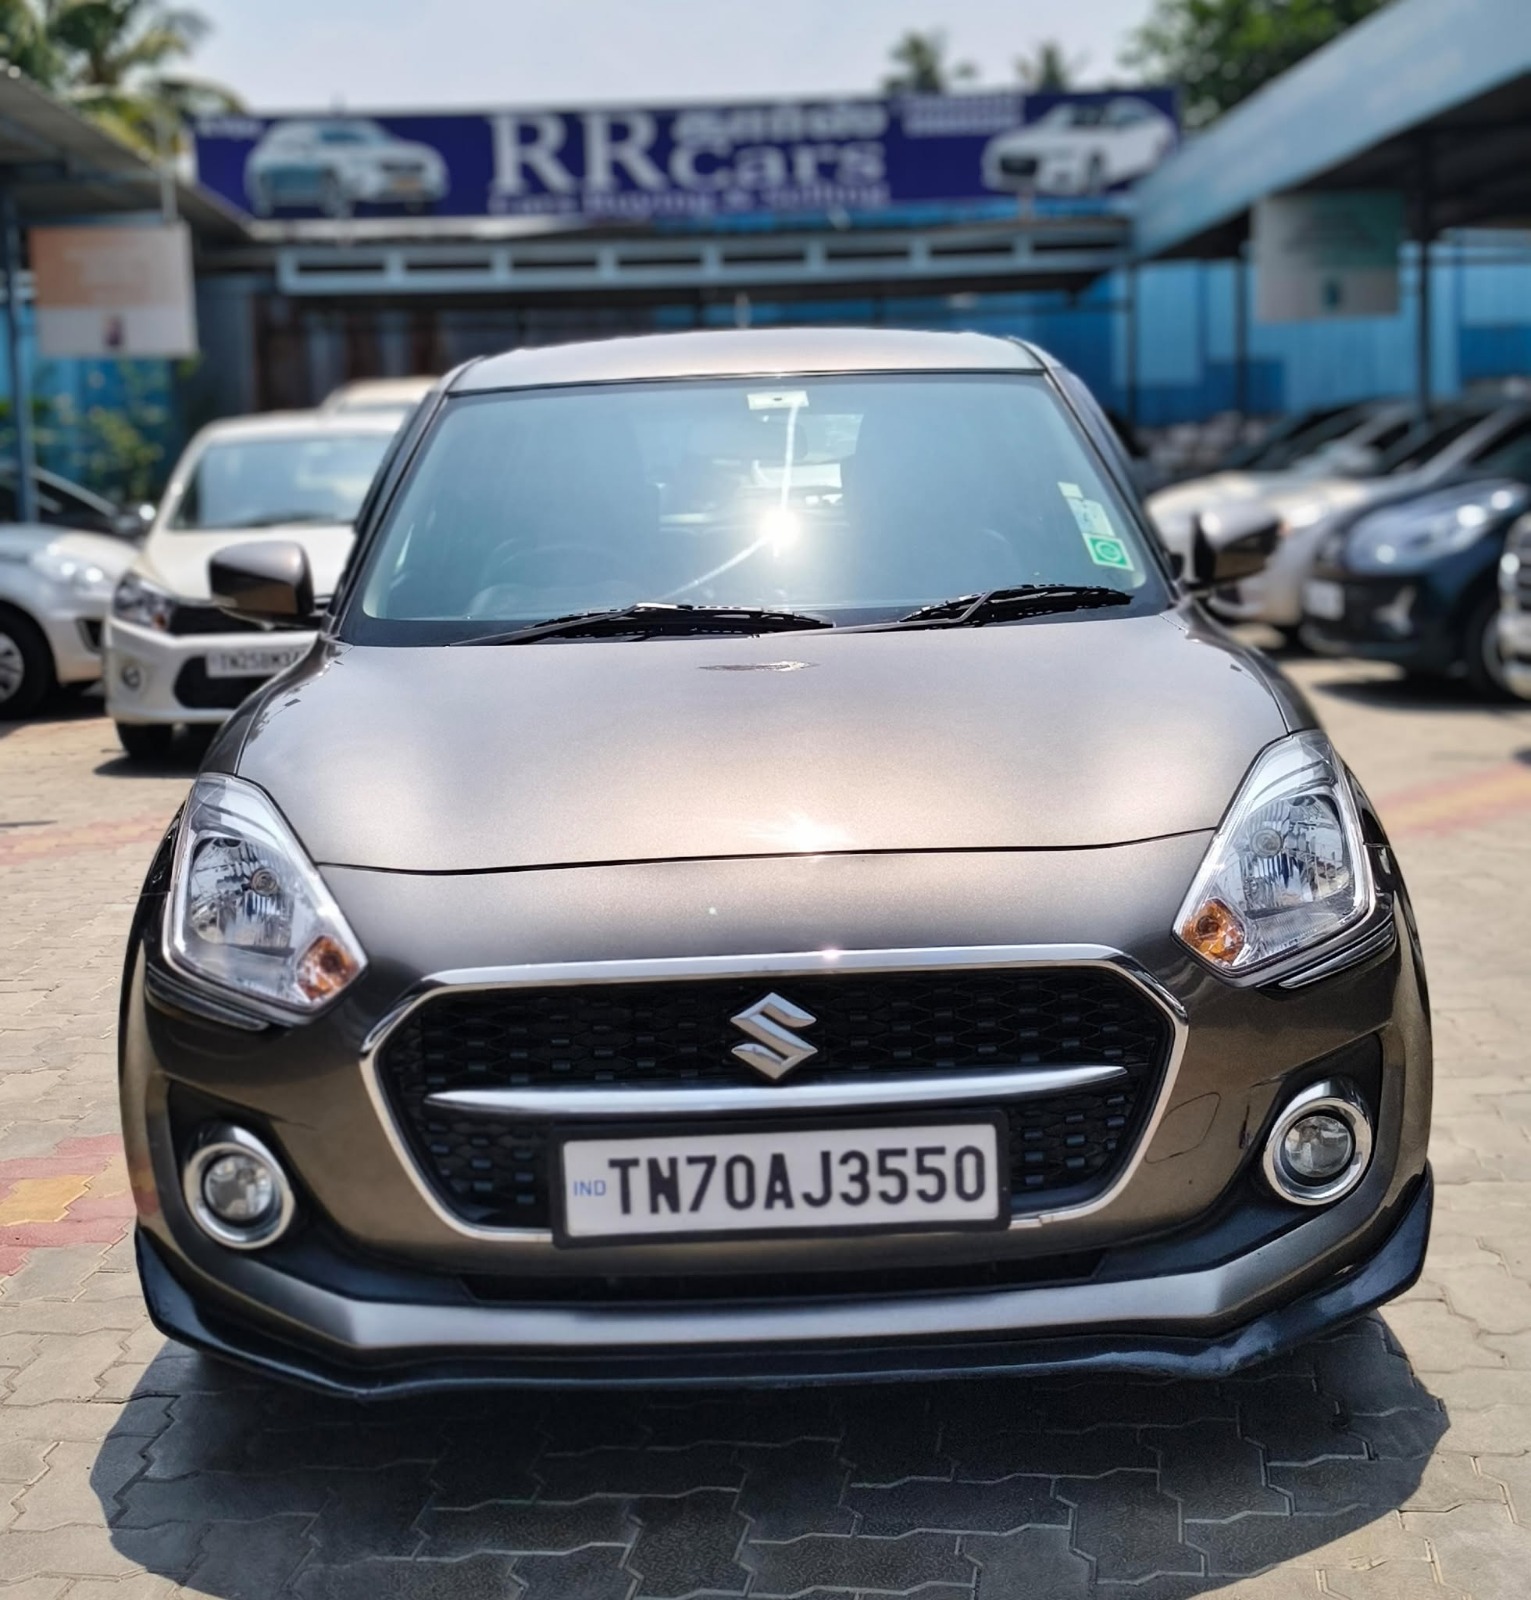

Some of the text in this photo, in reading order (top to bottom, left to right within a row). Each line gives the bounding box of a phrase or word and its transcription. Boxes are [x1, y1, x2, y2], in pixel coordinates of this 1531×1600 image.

[489, 113, 671, 194] RR
[573, 1180, 607, 1197] IND
[608, 1146, 987, 1215] TN70AJ3550
